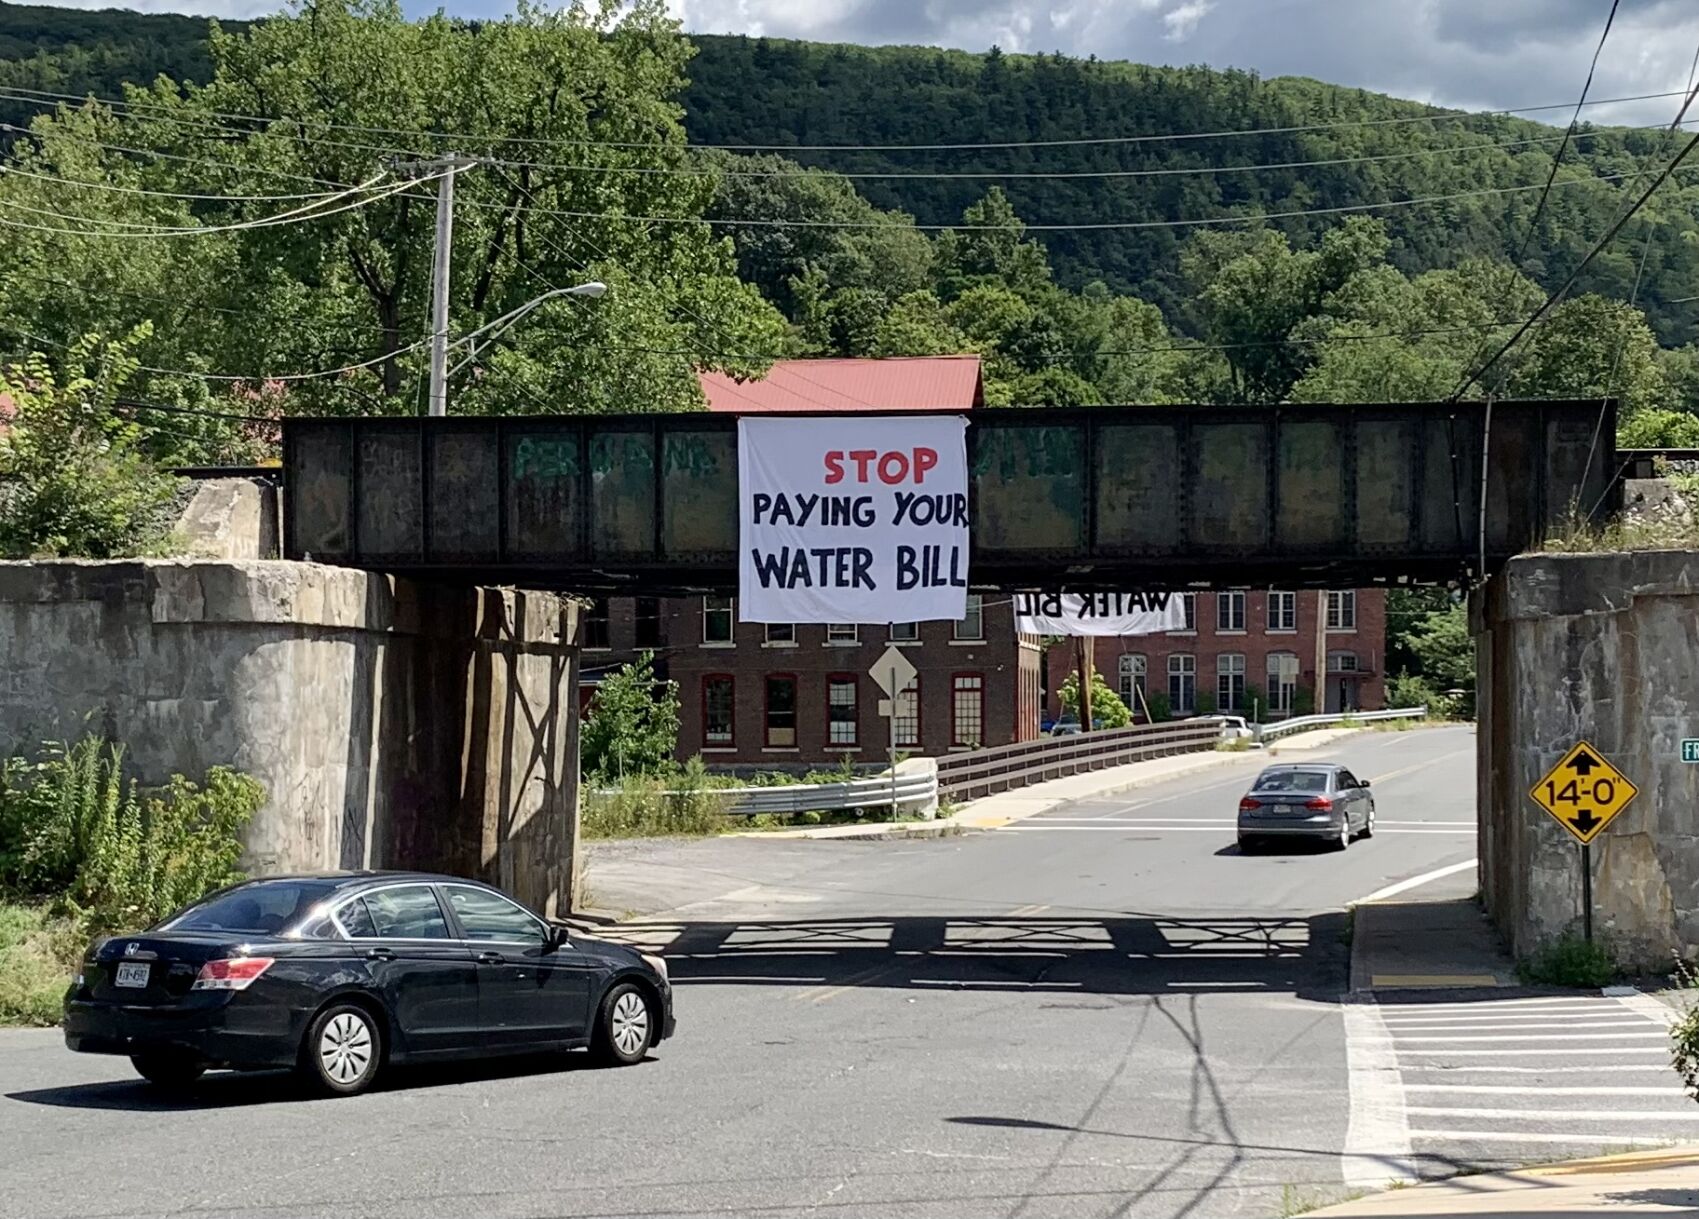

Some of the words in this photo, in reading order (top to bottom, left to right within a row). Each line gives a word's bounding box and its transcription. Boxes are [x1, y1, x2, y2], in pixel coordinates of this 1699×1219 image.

[825, 448, 938, 485] STOP
[753, 493, 876, 528] PAYING
[892, 491, 969, 529] YOUR
[752, 546, 876, 591] WATER
[896, 545, 966, 591] BILL
